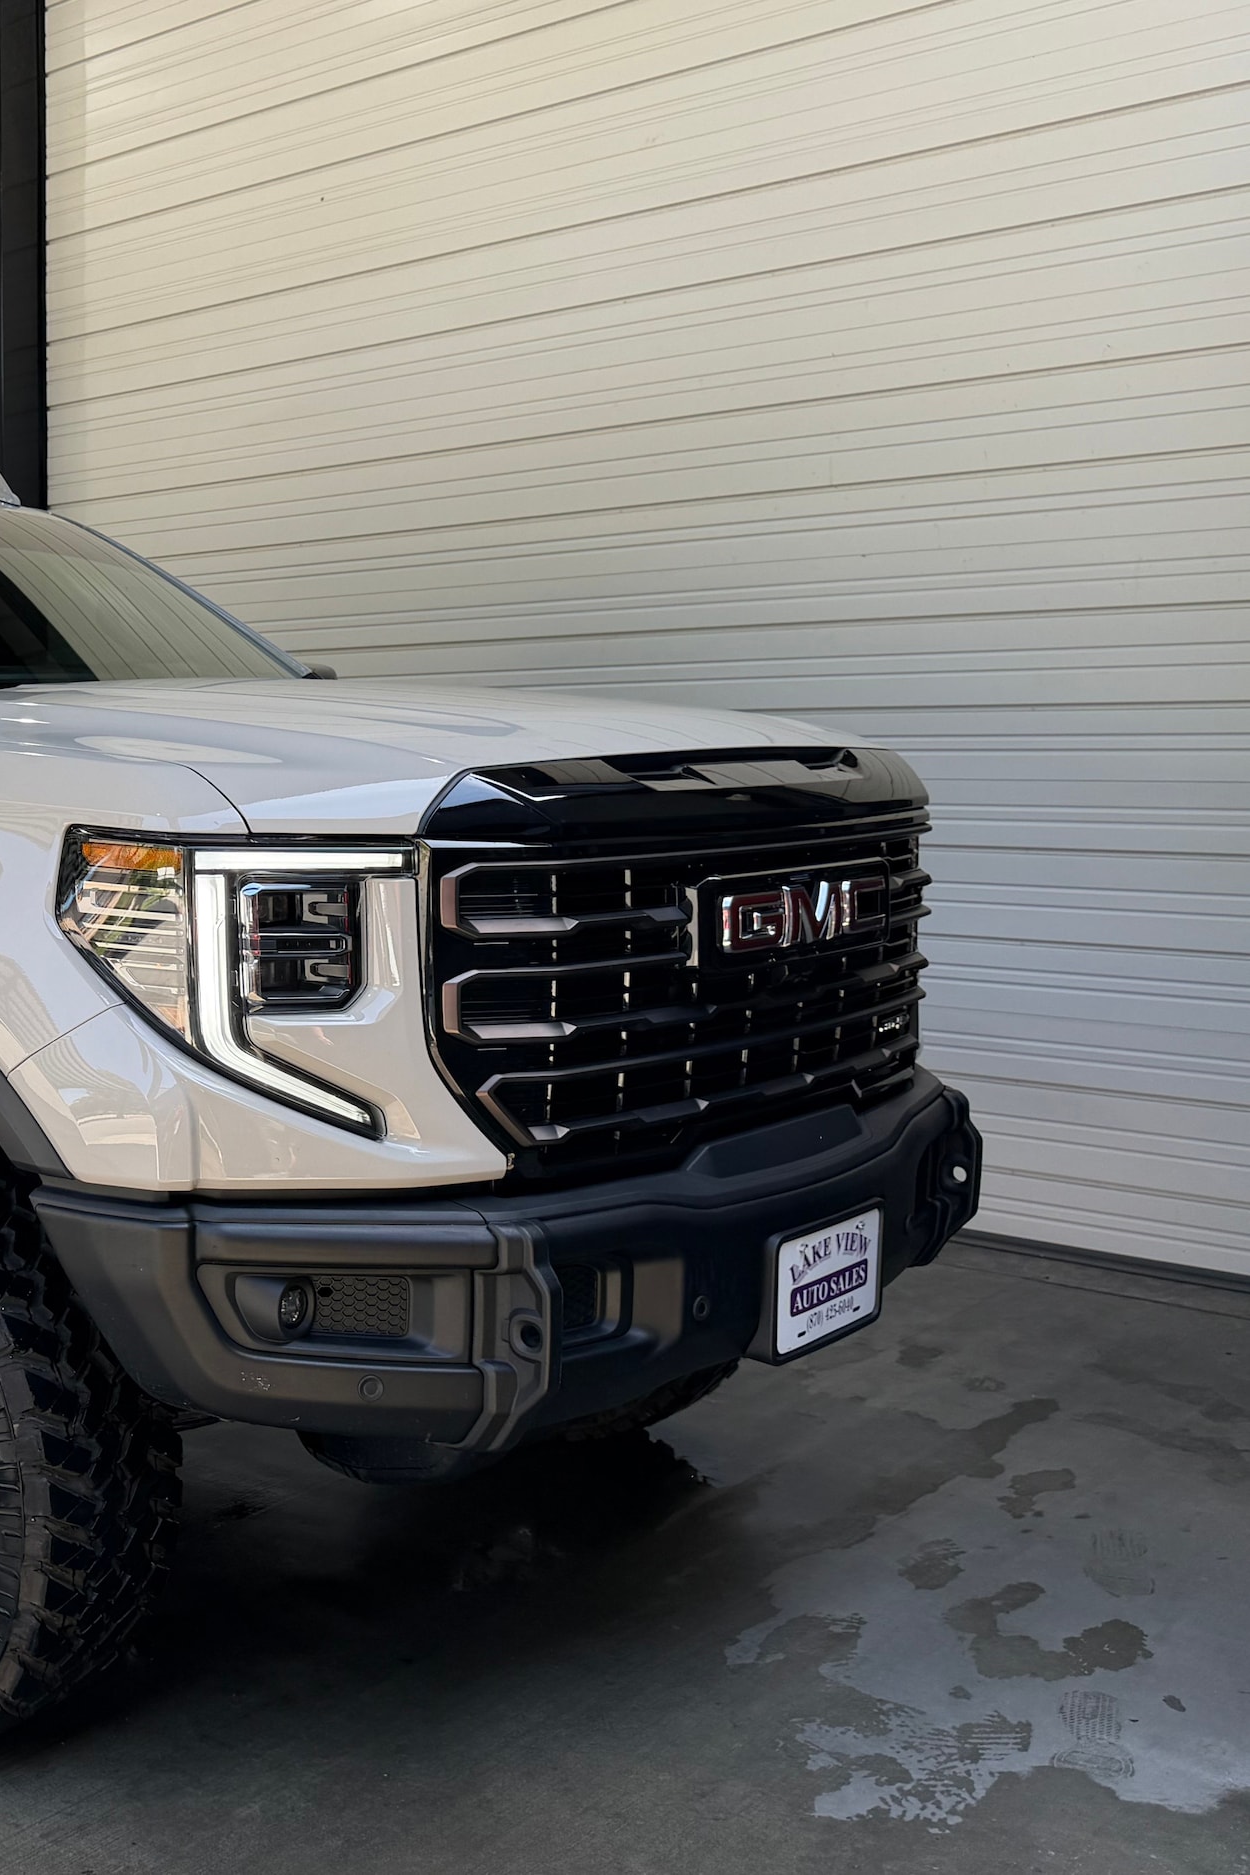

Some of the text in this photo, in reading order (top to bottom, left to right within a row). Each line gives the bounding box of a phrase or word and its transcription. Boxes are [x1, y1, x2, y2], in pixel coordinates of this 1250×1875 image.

[722, 879, 887, 954] GMC
[789, 1232, 872, 1285] LAKE VIEW
[793, 1264, 866, 1313] AUTO SALES
